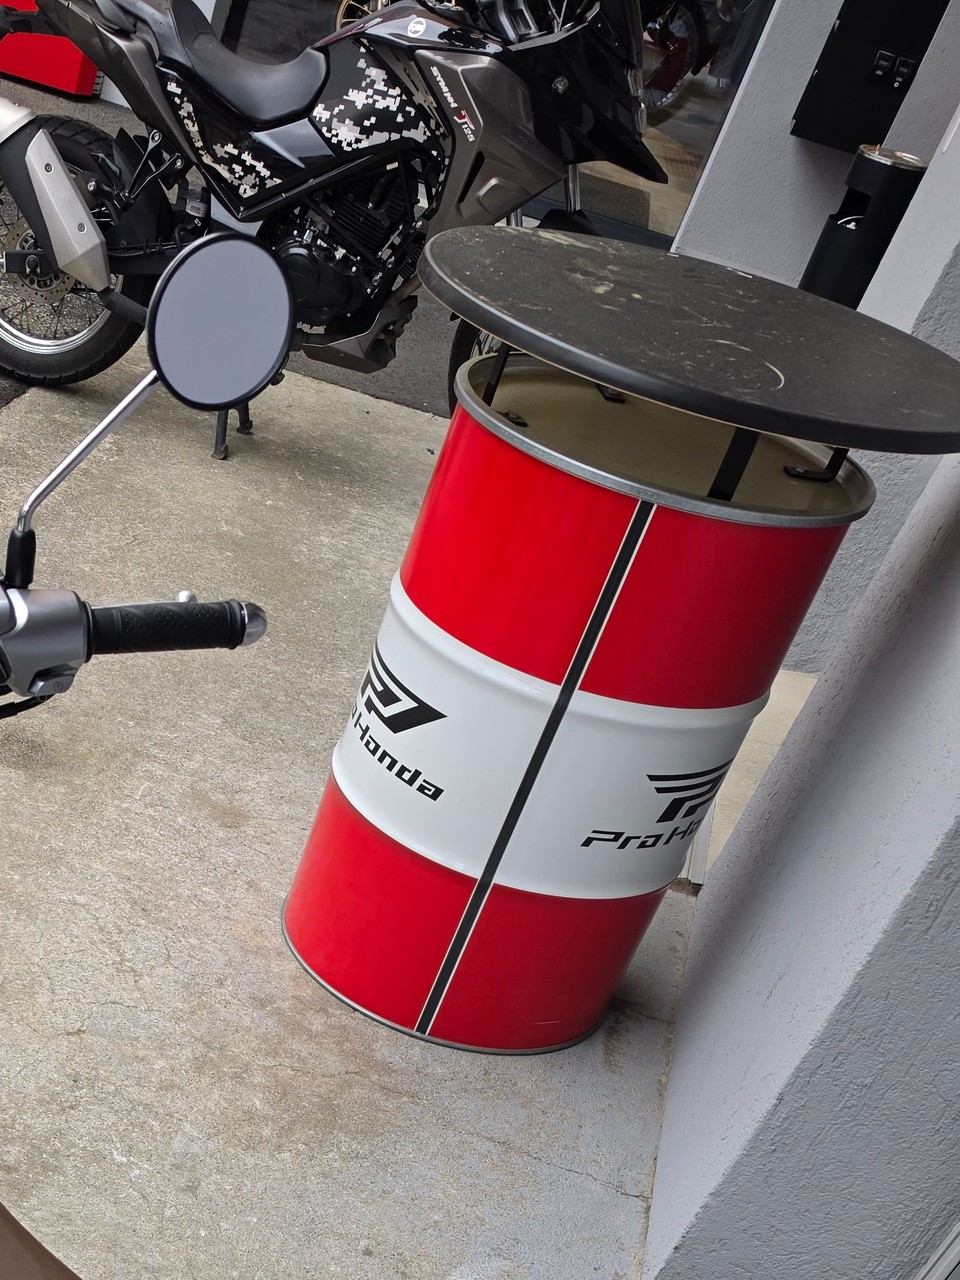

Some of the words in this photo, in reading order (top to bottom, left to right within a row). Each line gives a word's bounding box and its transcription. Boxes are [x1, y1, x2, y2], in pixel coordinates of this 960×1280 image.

[430, 65, 450, 93] SYM
[461, 123, 475, 142] 125
[354, 712, 444, 801] Honda
[580, 829, 664, 849] Pro
